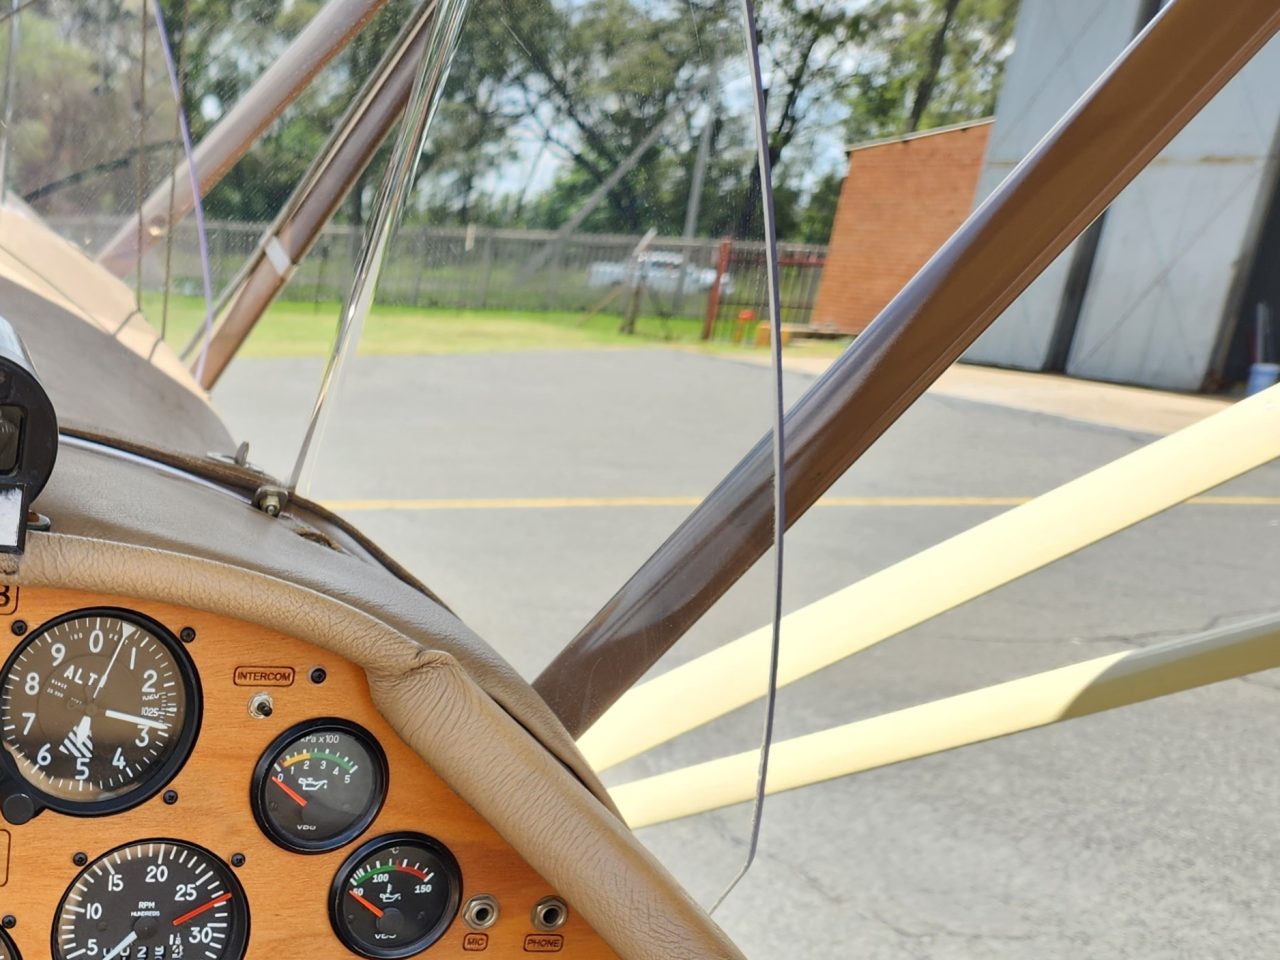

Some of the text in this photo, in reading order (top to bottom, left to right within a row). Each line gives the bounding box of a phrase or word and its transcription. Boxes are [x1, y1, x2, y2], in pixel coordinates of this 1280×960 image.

[89, 630, 104, 653] 0
[51, 643, 66, 667] 9
[130, 647, 136, 670] 1
[64, 664, 98, 686] ALT
[142, 670, 158, 692] 2
[238, 672, 291, 682] INTERCOM
[25, 672, 39, 695] 8
[141, 706, 160, 717] 1025
[22, 712, 36, 735] 7
[135, 725, 149, 747] 3
[37, 743, 52, 766] 6
[112, 747, 126, 770] 4
[75, 758, 90, 780] 5
[290, 766, 294, 775] 1
[303, 762, 310, 770] 2
[320, 761, 326, 770] 3
[332, 767, 339, 776] 4
[278, 774, 284, 782] 0
[344, 775, 351, 784] 5
[145, 866, 168, 882] 20
[372, 874, 389, 882] 100
[108, 874, 124, 892] 15
[414, 885, 432, 894] 150
[174, 884, 197, 902] 25
[352, 888, 364, 896] 50
[86, 902, 102, 919] 10
[138, 901, 155, 909] RPM
[188, 927, 212, 944] 30
[467, 938, 484, 946] MIC
[527, 939, 560, 948] PHONE
[87, 939, 98, 954] 5
